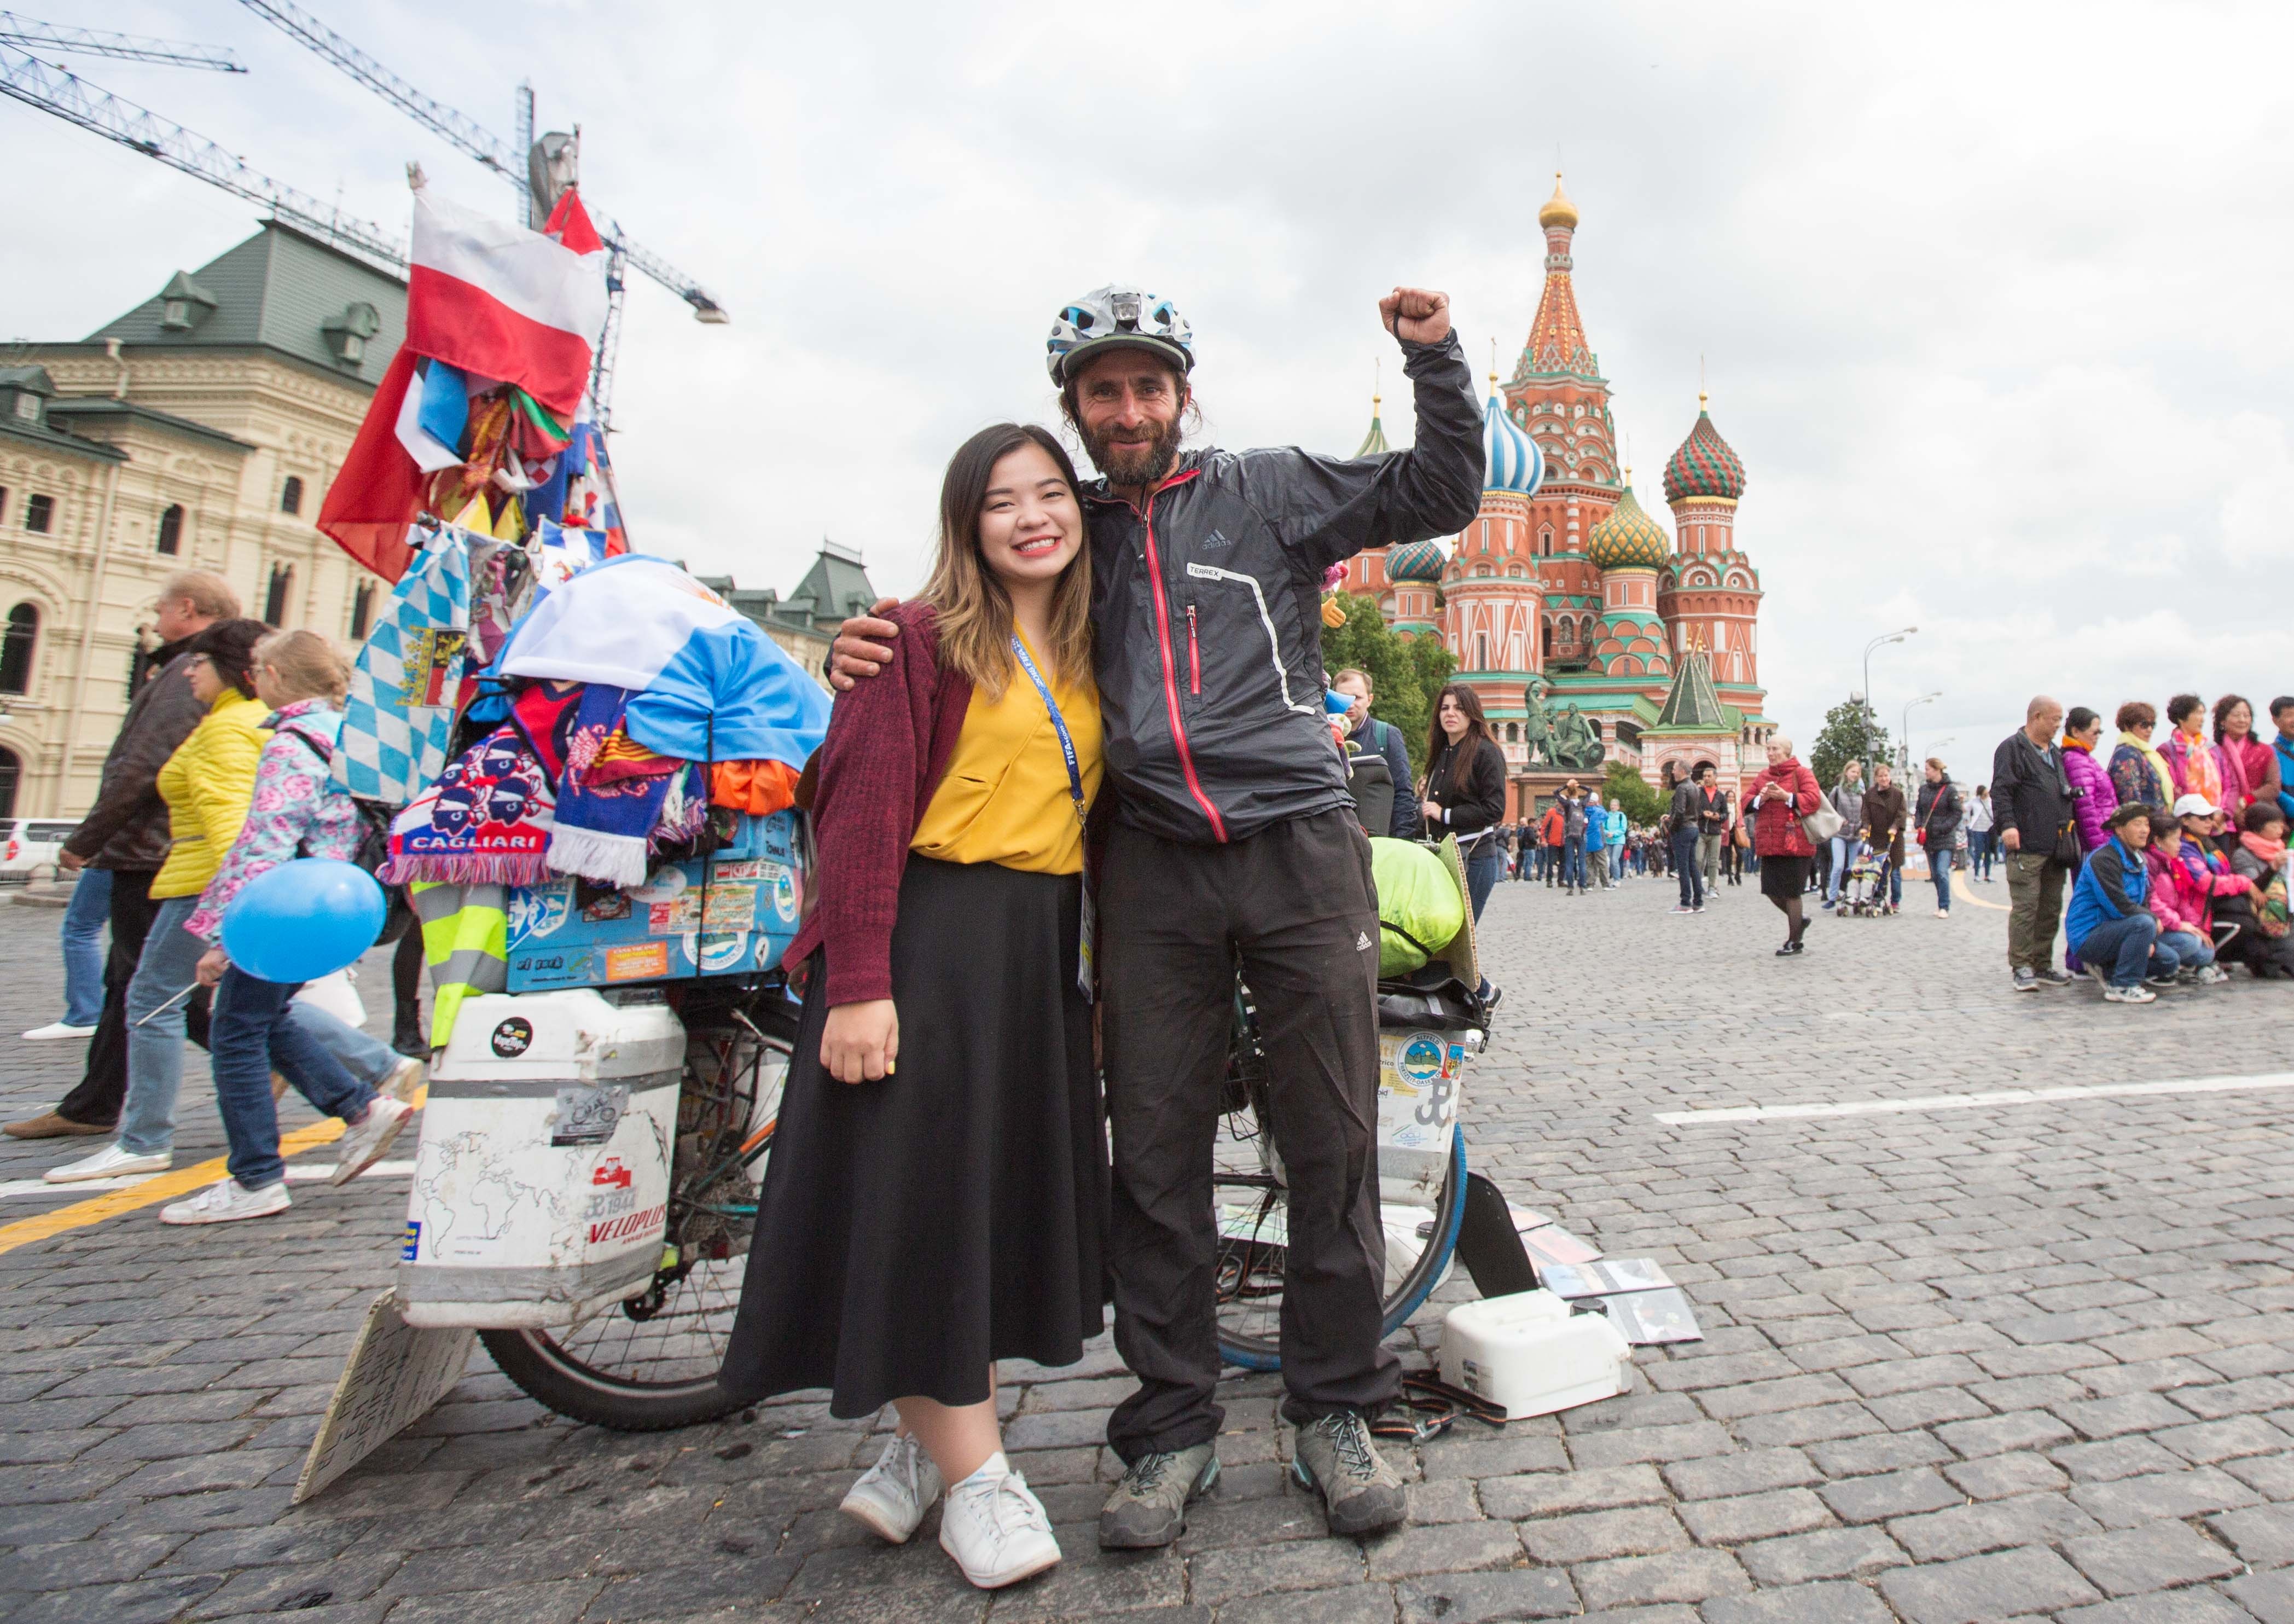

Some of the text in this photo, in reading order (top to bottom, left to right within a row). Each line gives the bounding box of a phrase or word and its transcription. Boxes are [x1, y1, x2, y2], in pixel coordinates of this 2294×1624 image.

[1201, 540, 1231, 550] adidas
[1190, 566, 1219, 577] TERREX
[1018, 648, 1043, 686] 2018 FIFA
[1060, 725, 1075, 766] FIFA.com
[411, 834, 537, 849] CAGLIARI
[1416, 1036, 1439, 1045] ALTFELD
[590, 1203, 666, 1244] VELOPLUS
